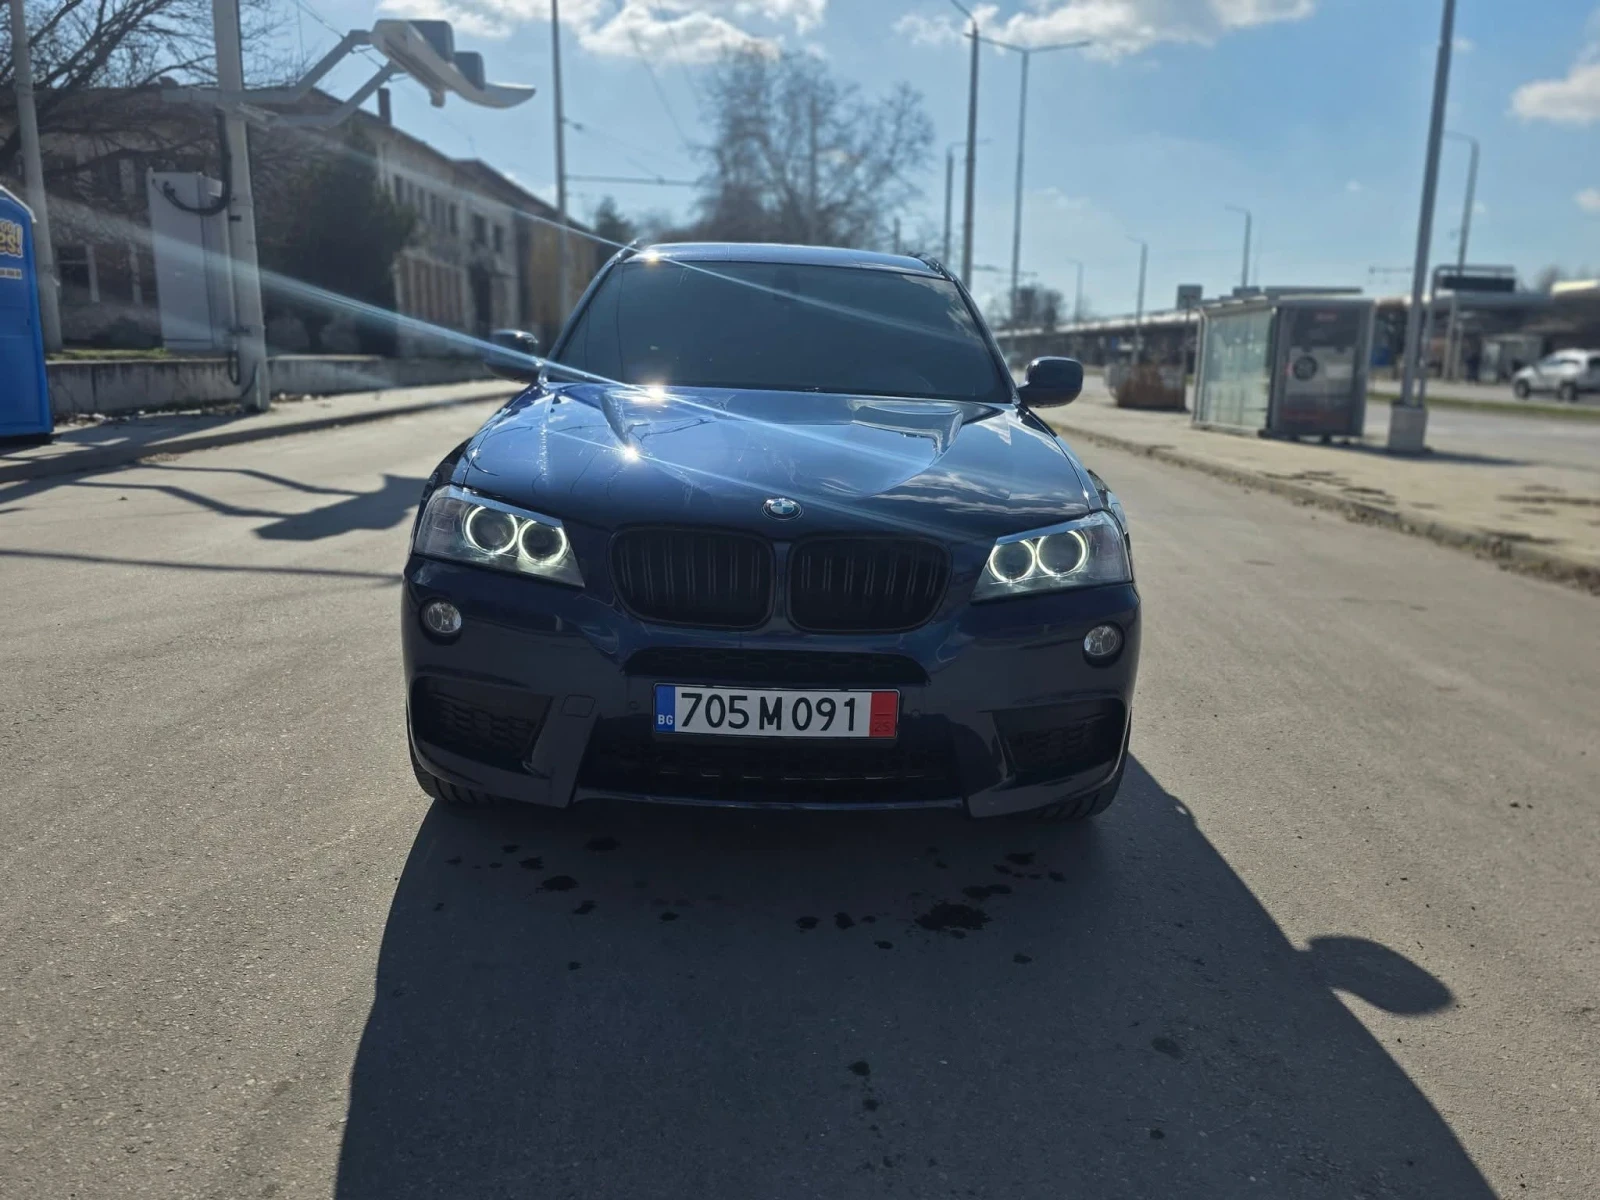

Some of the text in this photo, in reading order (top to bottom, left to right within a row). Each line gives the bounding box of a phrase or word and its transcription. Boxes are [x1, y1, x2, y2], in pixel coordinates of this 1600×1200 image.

[657, 714, 674, 726] BG
[681, 692, 856, 731] 705 M 091
